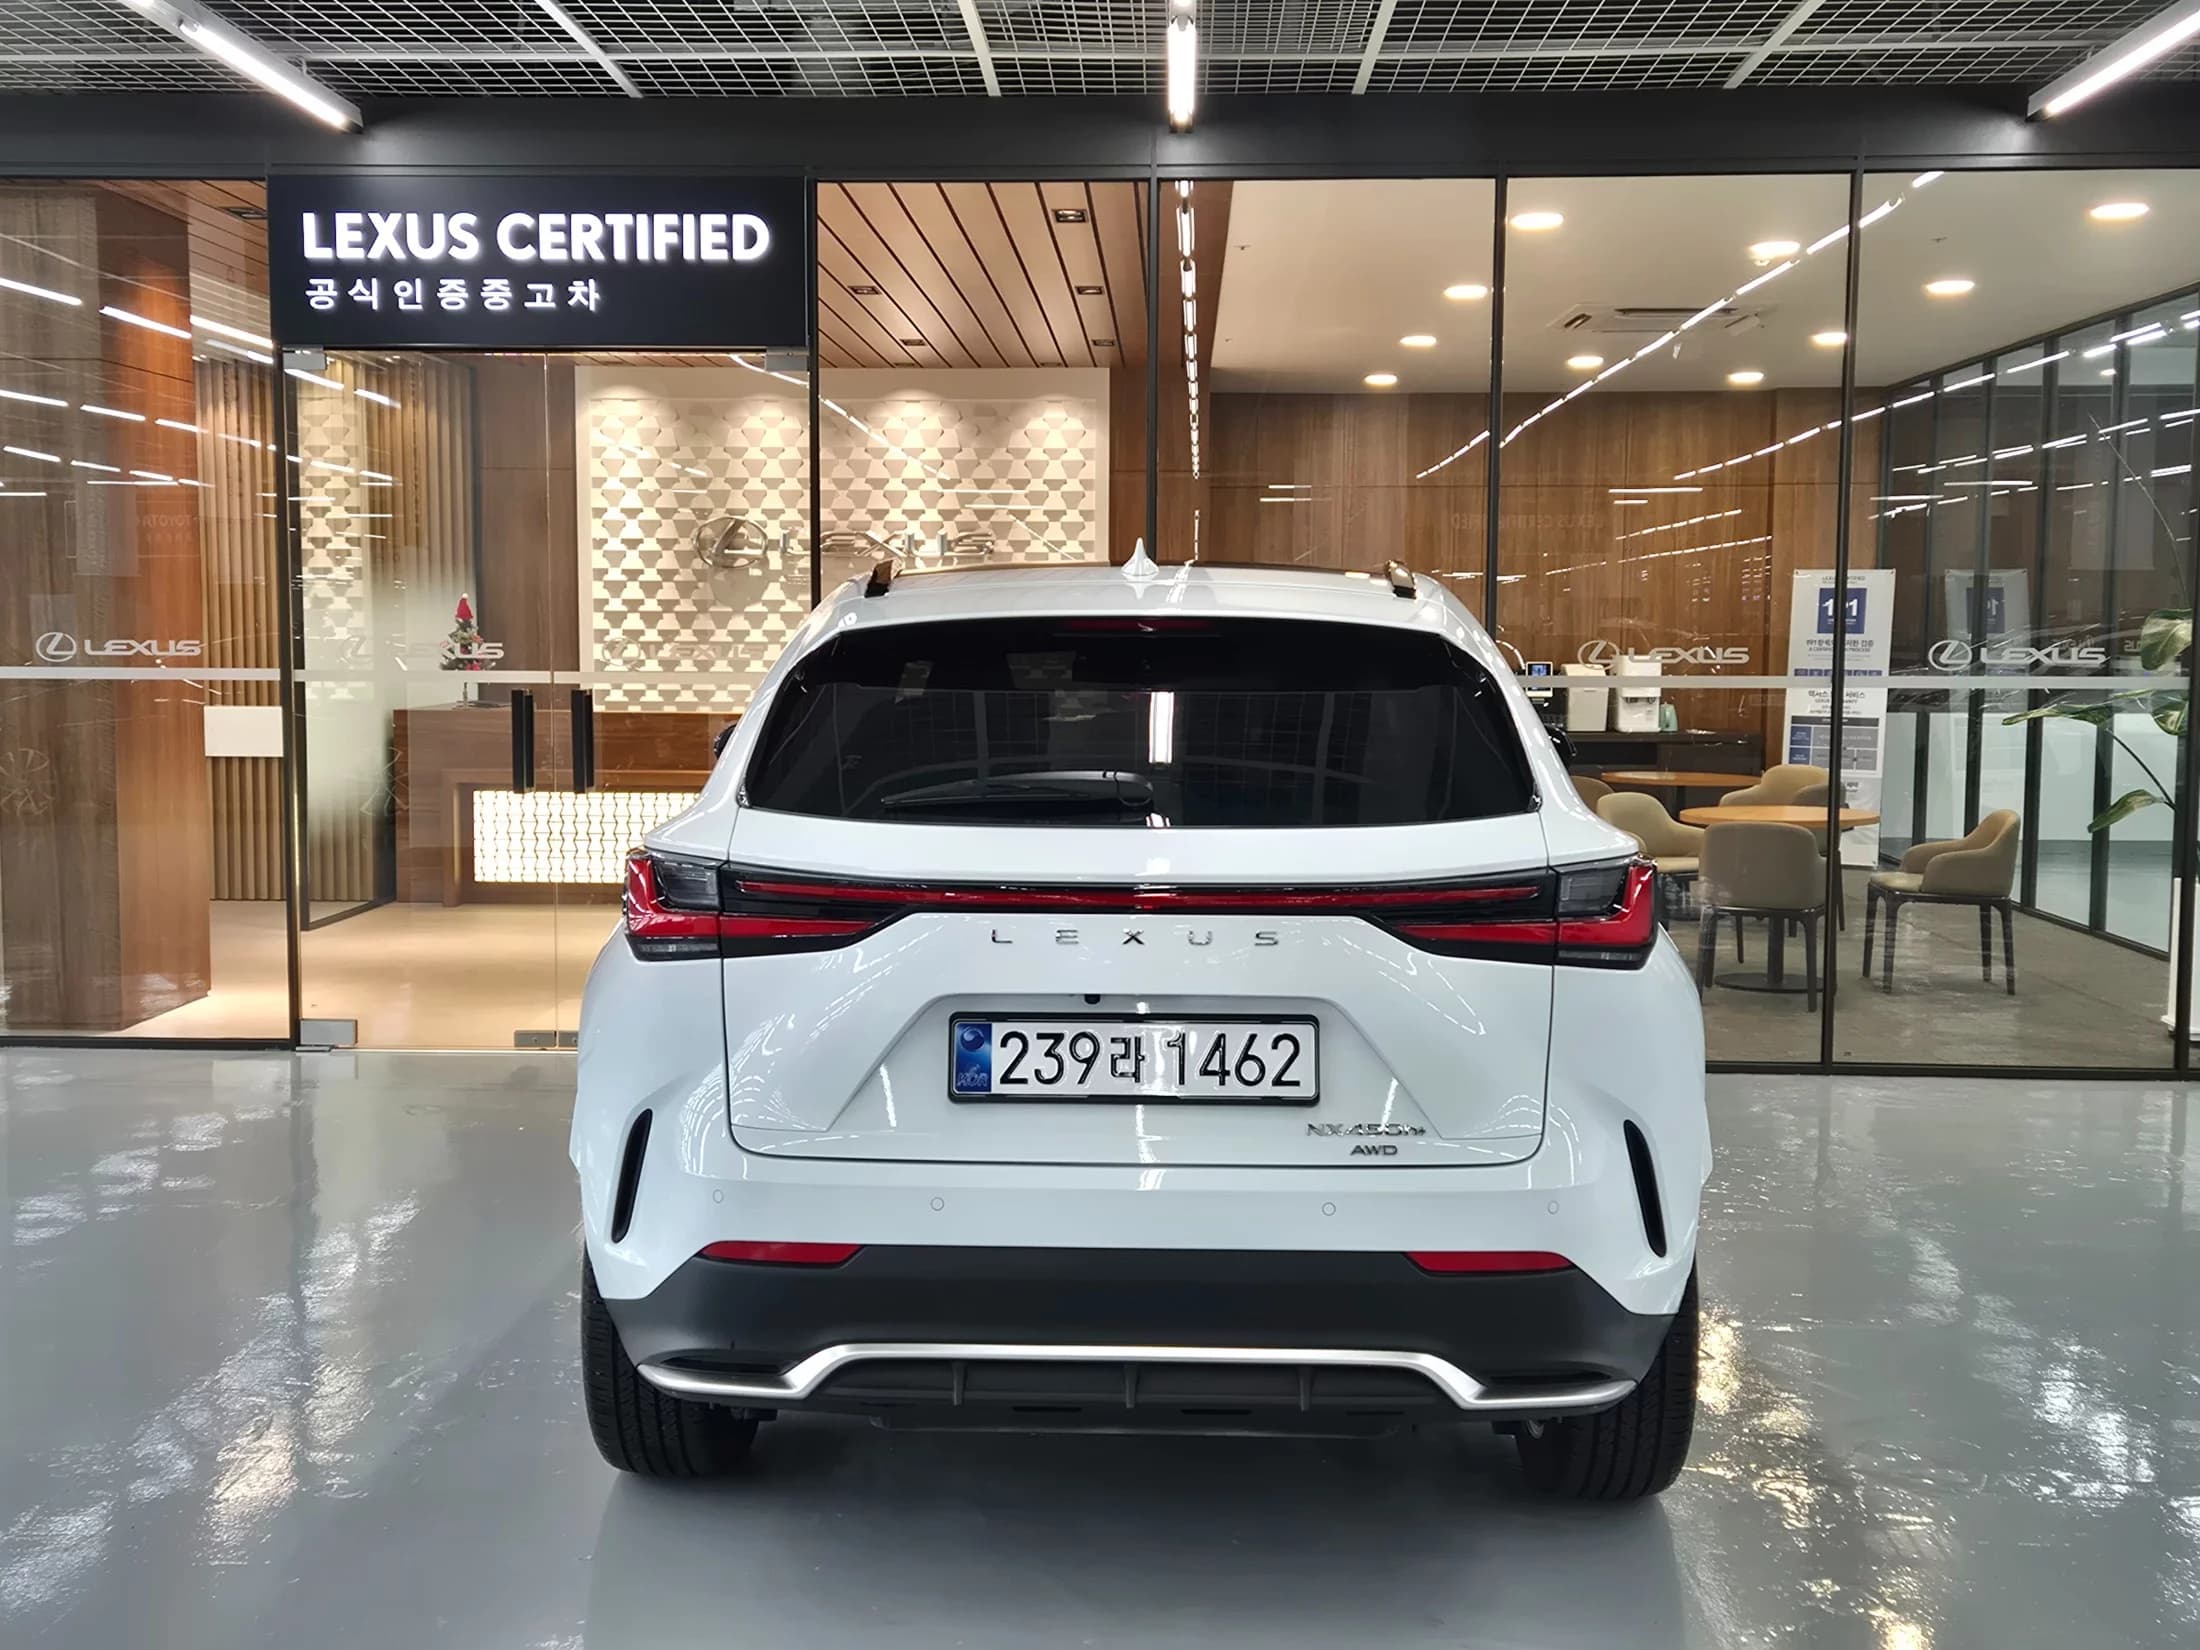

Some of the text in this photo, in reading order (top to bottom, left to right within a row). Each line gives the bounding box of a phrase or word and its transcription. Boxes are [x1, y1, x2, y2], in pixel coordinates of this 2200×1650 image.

[302, 212, 771, 262] LEXUS CERTIFIED
[84, 639, 201, 656] LEXUS
[1628, 647, 1750, 664] LEXUS
[1980, 647, 2106, 665] LEXUS
[990, 928, 1279, 946] LEXUS
[1167, 1032, 1300, 1086] 1462
[1350, 1145, 1398, 1156] AWD
